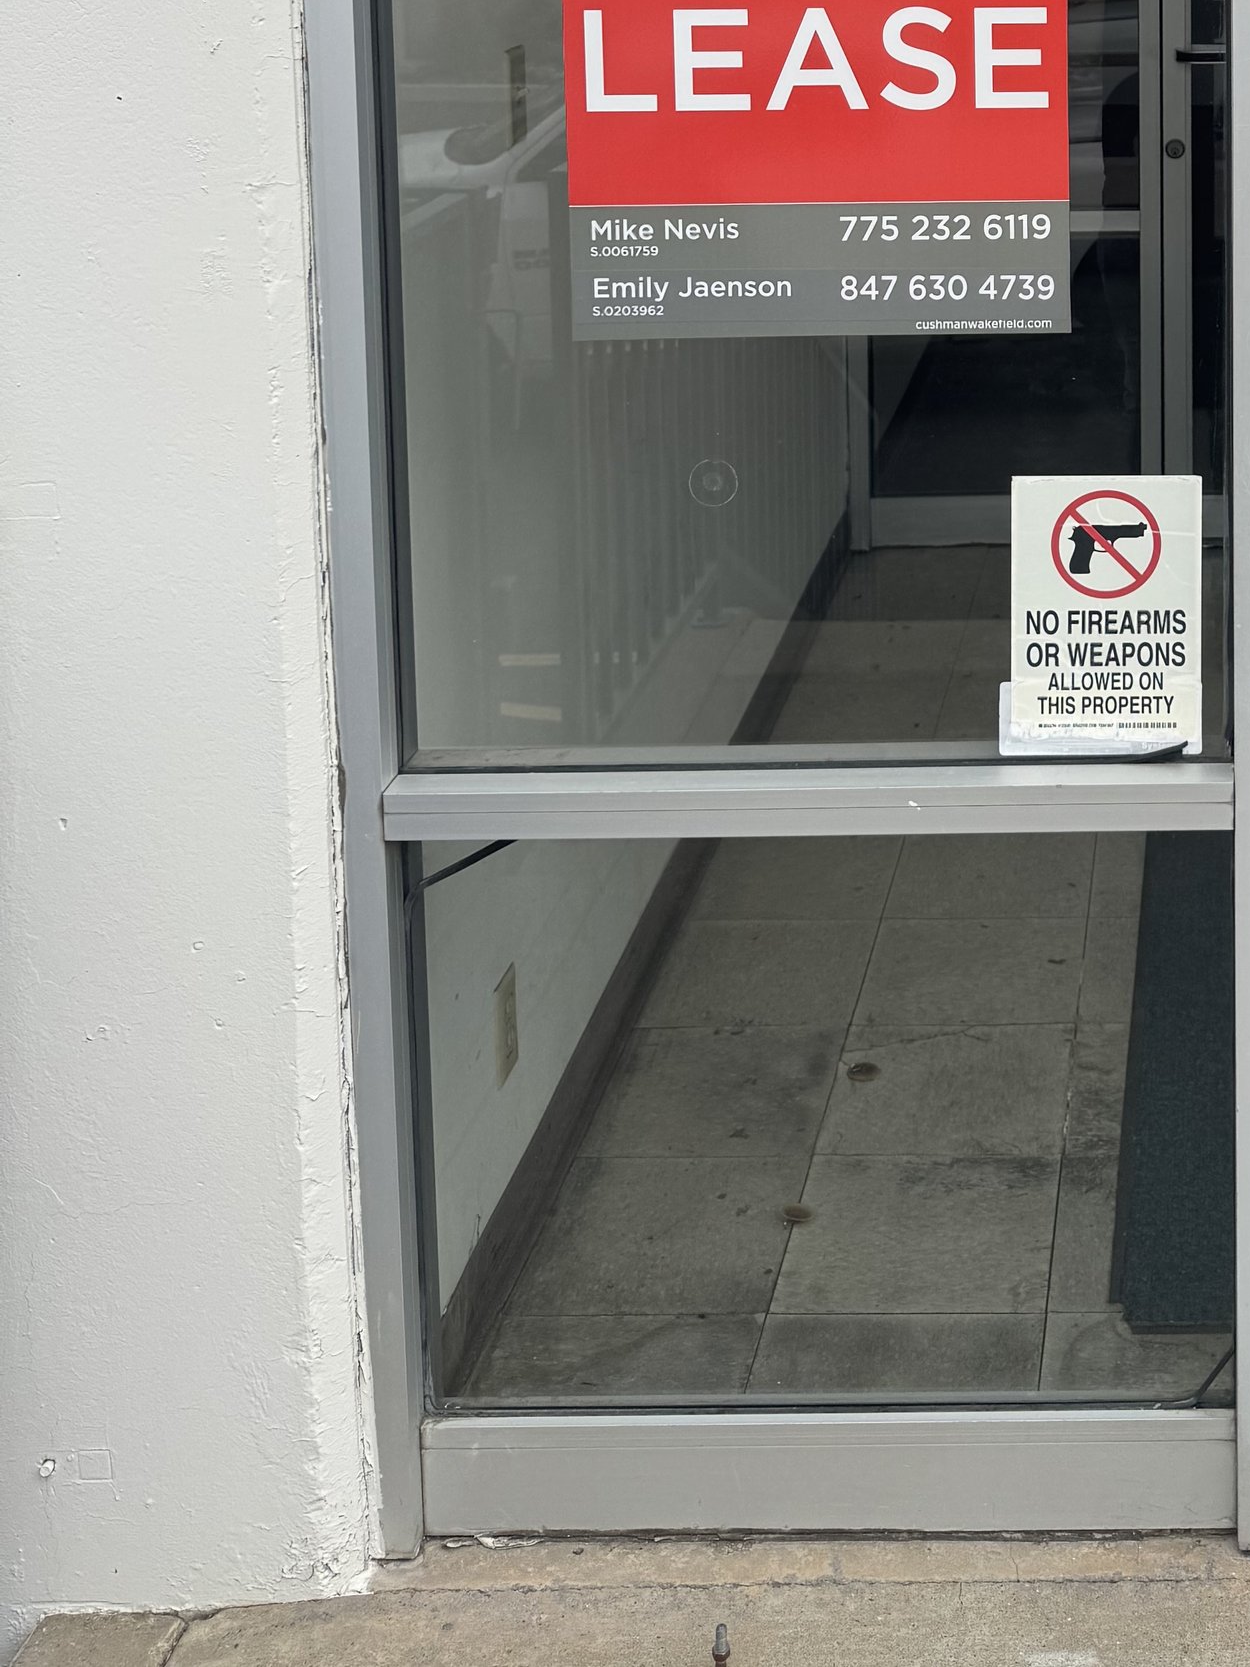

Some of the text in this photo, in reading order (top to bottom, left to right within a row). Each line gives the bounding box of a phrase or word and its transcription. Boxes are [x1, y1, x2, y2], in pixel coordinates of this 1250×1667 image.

[583, 6, 1050, 113] LEASE
[591, 217, 740, 241] Mike Nevis
[839, 213, 1051, 242] 775 232 6119
[590, 245, 659, 257] S.0061759
[593, 276, 792, 302] Emily Jaenson
[840, 274, 1055, 301] 847 630 4739
[592, 305, 664, 317] S.0203962
[915, 319, 1052, 330] cushmanwakefield.com
[1026, 609, 1187, 636] NO FIREARMS
[1026, 641, 1186, 668] OR WEAPONS
[1047, 671, 1164, 691] ALLOWED ON
[1037, 695, 1174, 715] THIS PROPERTY
